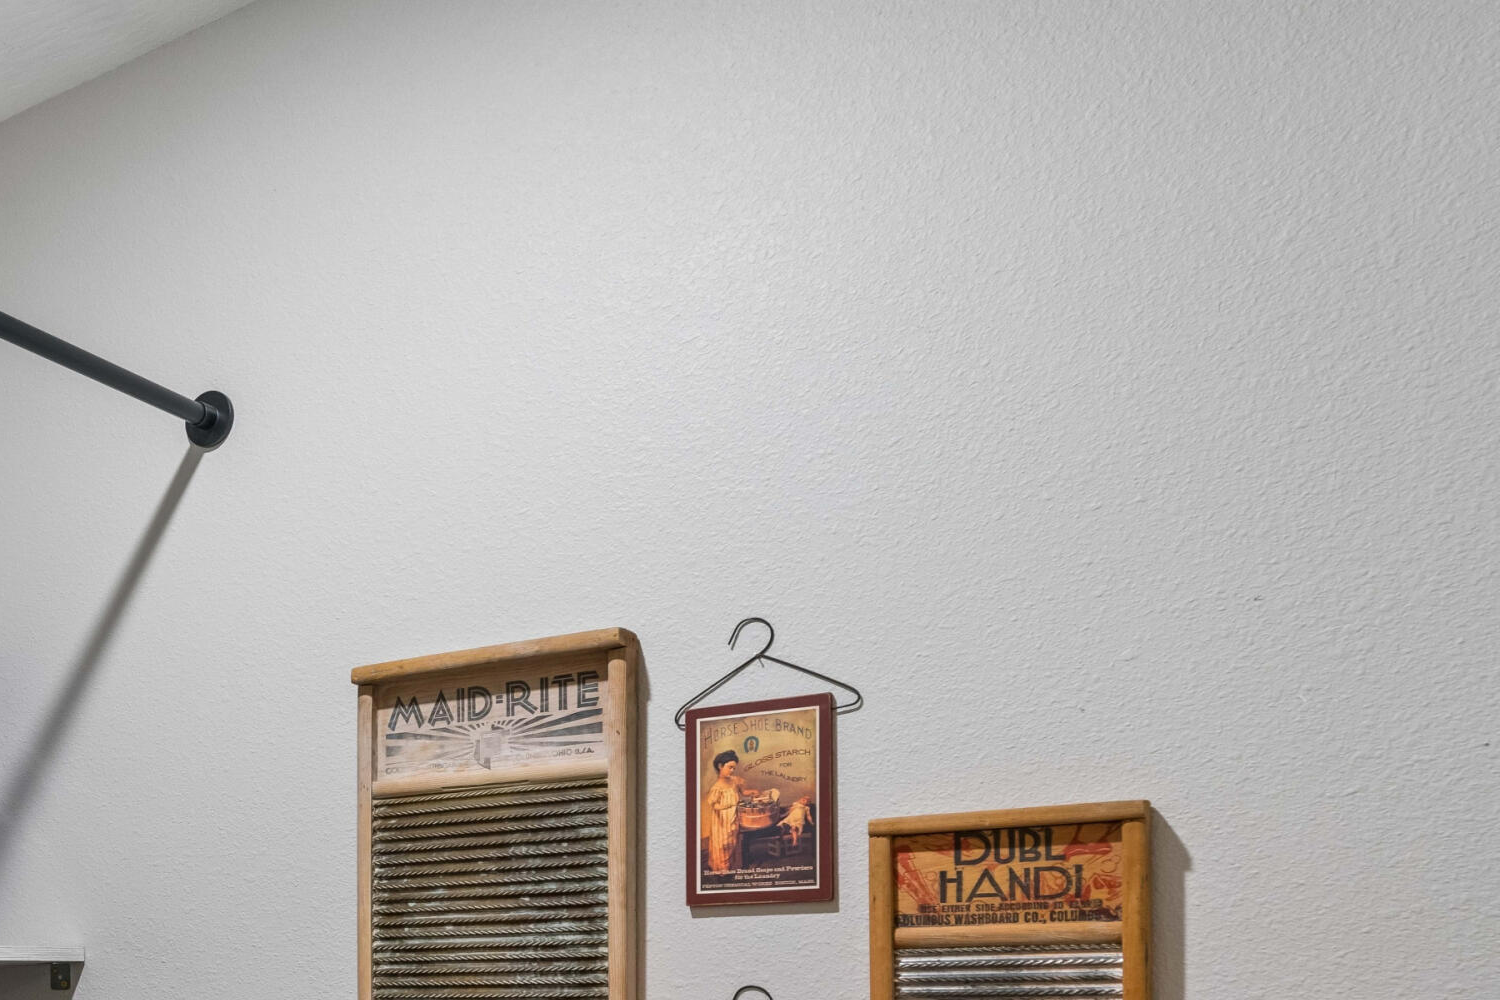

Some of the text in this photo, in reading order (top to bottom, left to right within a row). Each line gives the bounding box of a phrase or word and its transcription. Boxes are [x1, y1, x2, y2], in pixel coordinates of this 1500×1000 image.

[704, 719, 812, 749] HORSE SHOE BRAND
[775, 749, 811, 759] STARCH
[954, 827, 1066, 866] DUBL
[940, 864, 1083, 903] HANDI
[942, 904, 971, 913] EITHER
[975, 903, 996, 912] SIDE
[955, 912, 1019, 925] WASHBOARD
